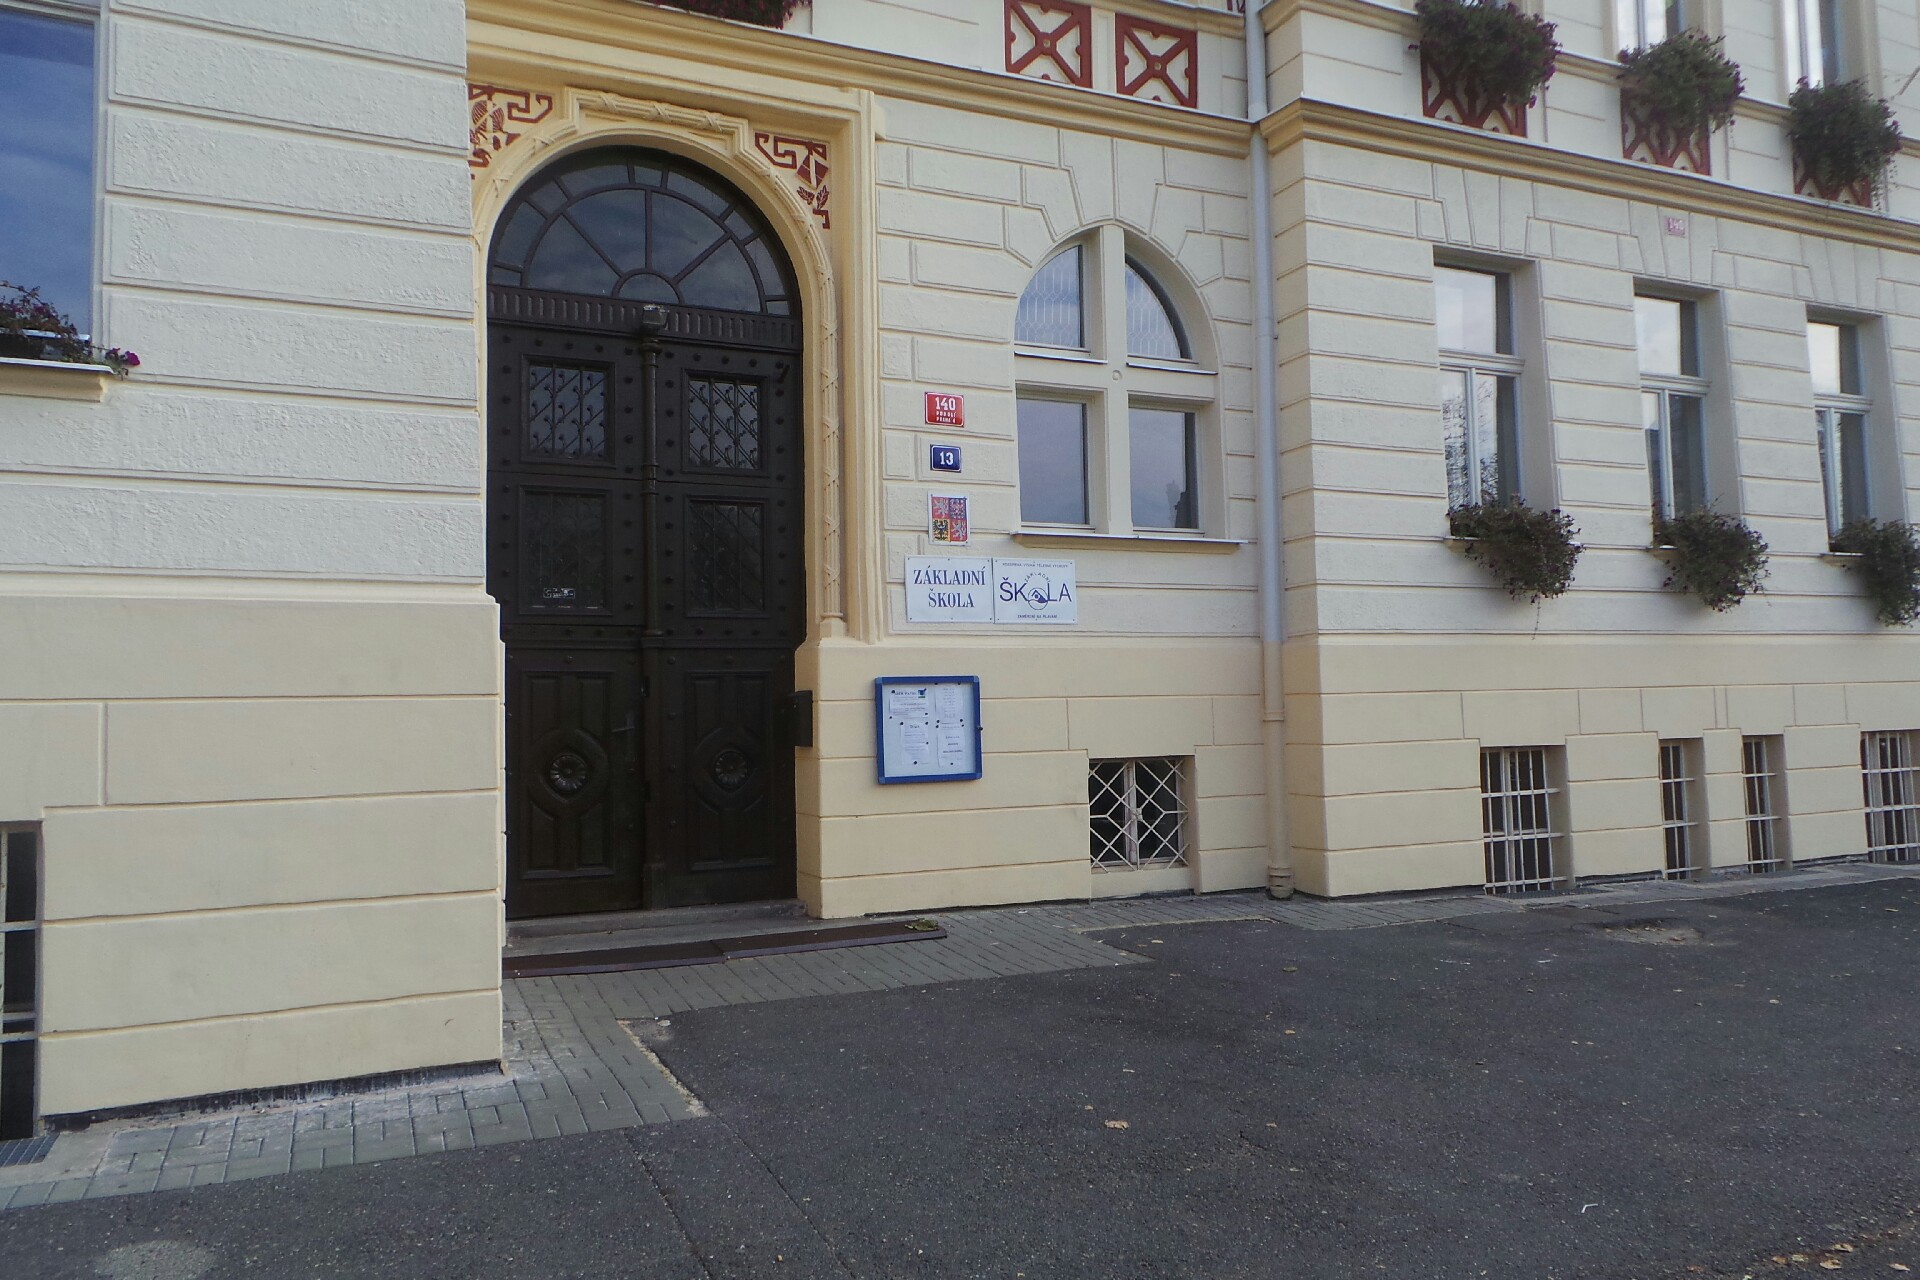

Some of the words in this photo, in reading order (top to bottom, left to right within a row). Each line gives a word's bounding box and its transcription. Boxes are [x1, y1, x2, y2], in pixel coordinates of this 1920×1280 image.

[935, 396, 956, 411] 140
[939, 451, 954, 466] 13
[913, 565, 986, 586] ZÁKLADNÍ
[928, 588, 975, 608] ŠKOLA
